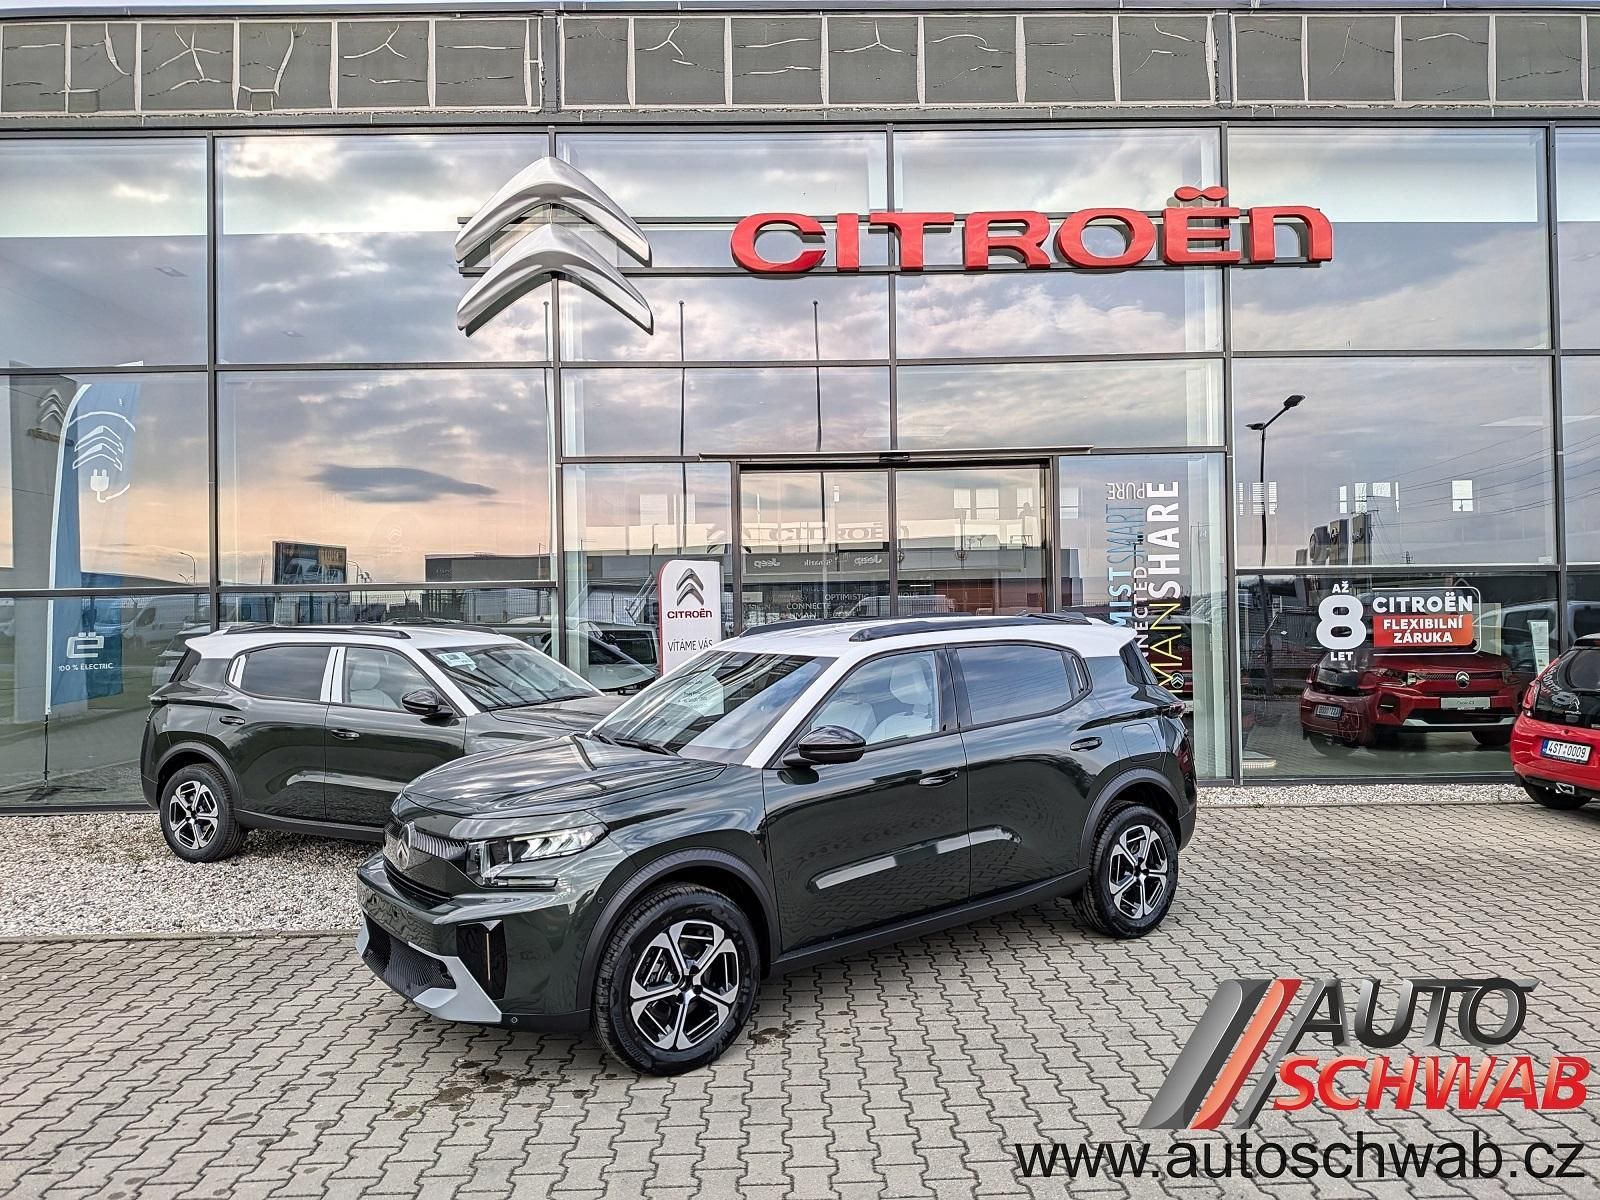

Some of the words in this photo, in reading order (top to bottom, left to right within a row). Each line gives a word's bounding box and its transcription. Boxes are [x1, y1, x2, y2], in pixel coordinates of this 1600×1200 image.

[731, 185, 1333, 273] CITROËN
[1105, 482, 1145, 500] PURE
[1146, 481, 1180, 599] SHARE
[1332, 581, 1350, 593] AŽ
[1372, 592, 1473, 613] CITROËN
[667, 608, 713, 619] CITROËN
[1316, 594, 1367, 650] 8
[1383, 614, 1463, 630] FLEXIBILNÍ
[667, 639, 697, 652] VÍTÁME
[1393, 631, 1453, 644] ZÁRUKA
[1330, 651, 1354, 661] LET
[80, 662, 114, 671] ELECTRIC
[1548, 742, 1563, 756] 4ST
[1566, 745, 1587, 758] 0009
